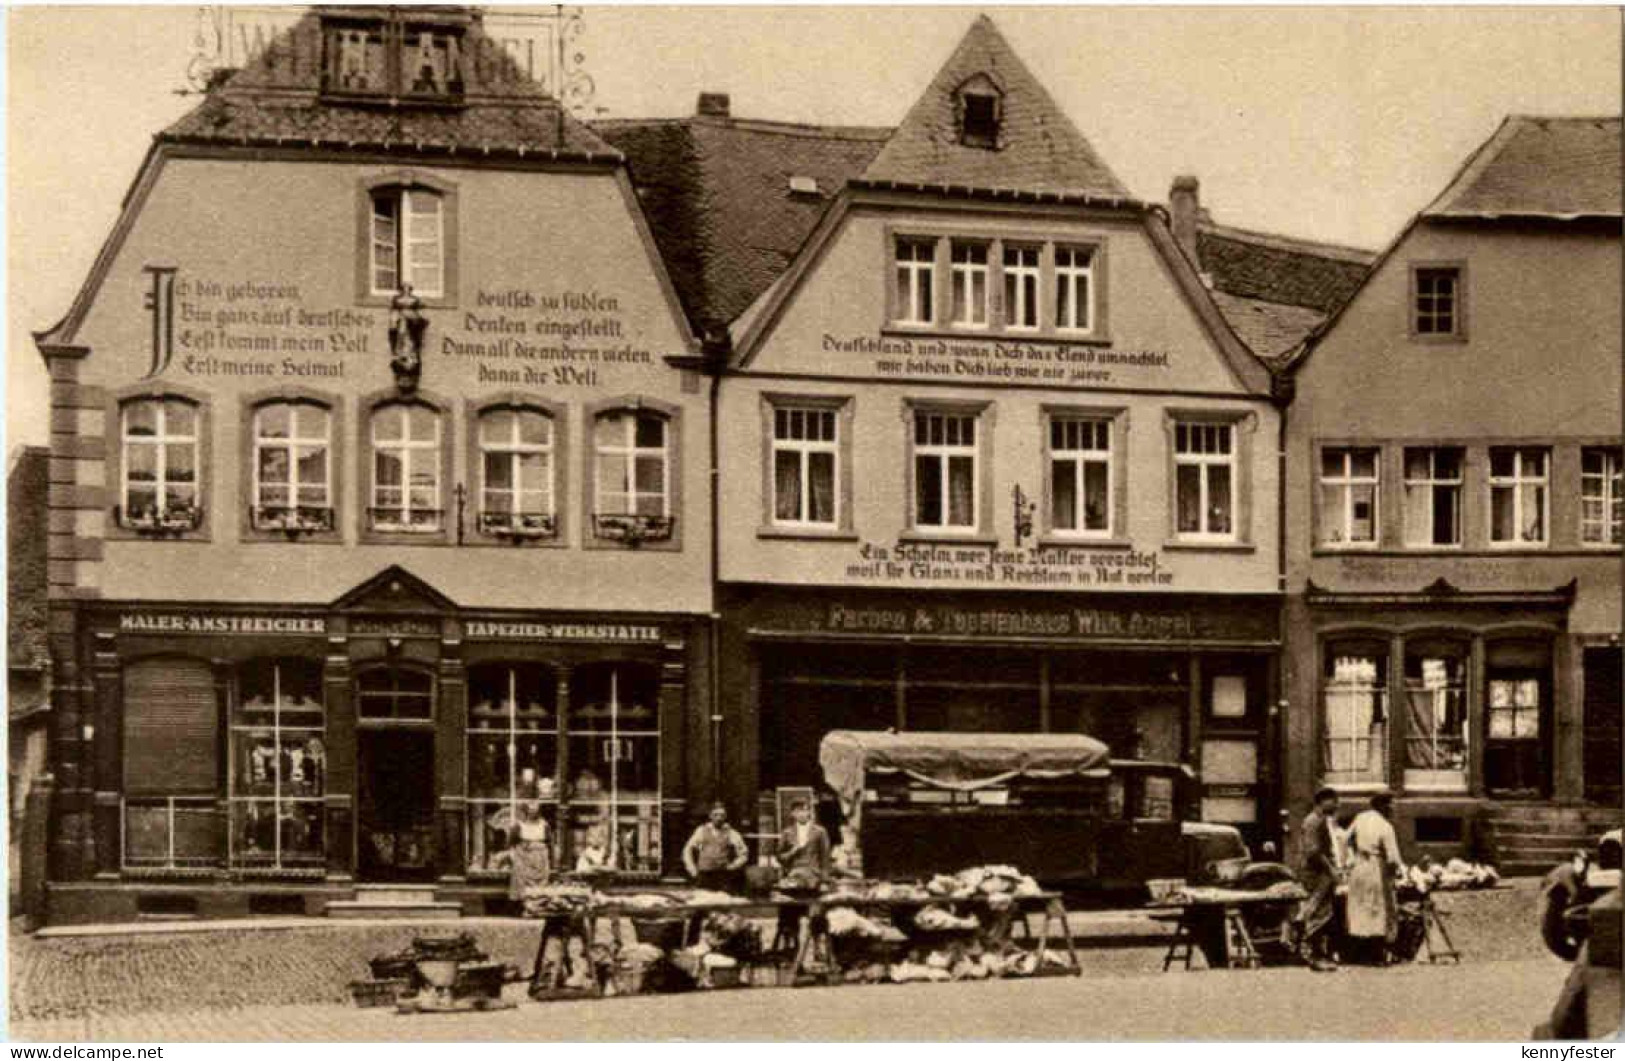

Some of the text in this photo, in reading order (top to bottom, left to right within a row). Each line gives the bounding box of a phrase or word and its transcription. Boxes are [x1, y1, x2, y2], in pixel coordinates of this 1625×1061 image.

[261, 308, 292, 330] auf
[282, 335, 325, 353] mein
[222, 359, 274, 376] meine
[914, 608, 934, 631] &
